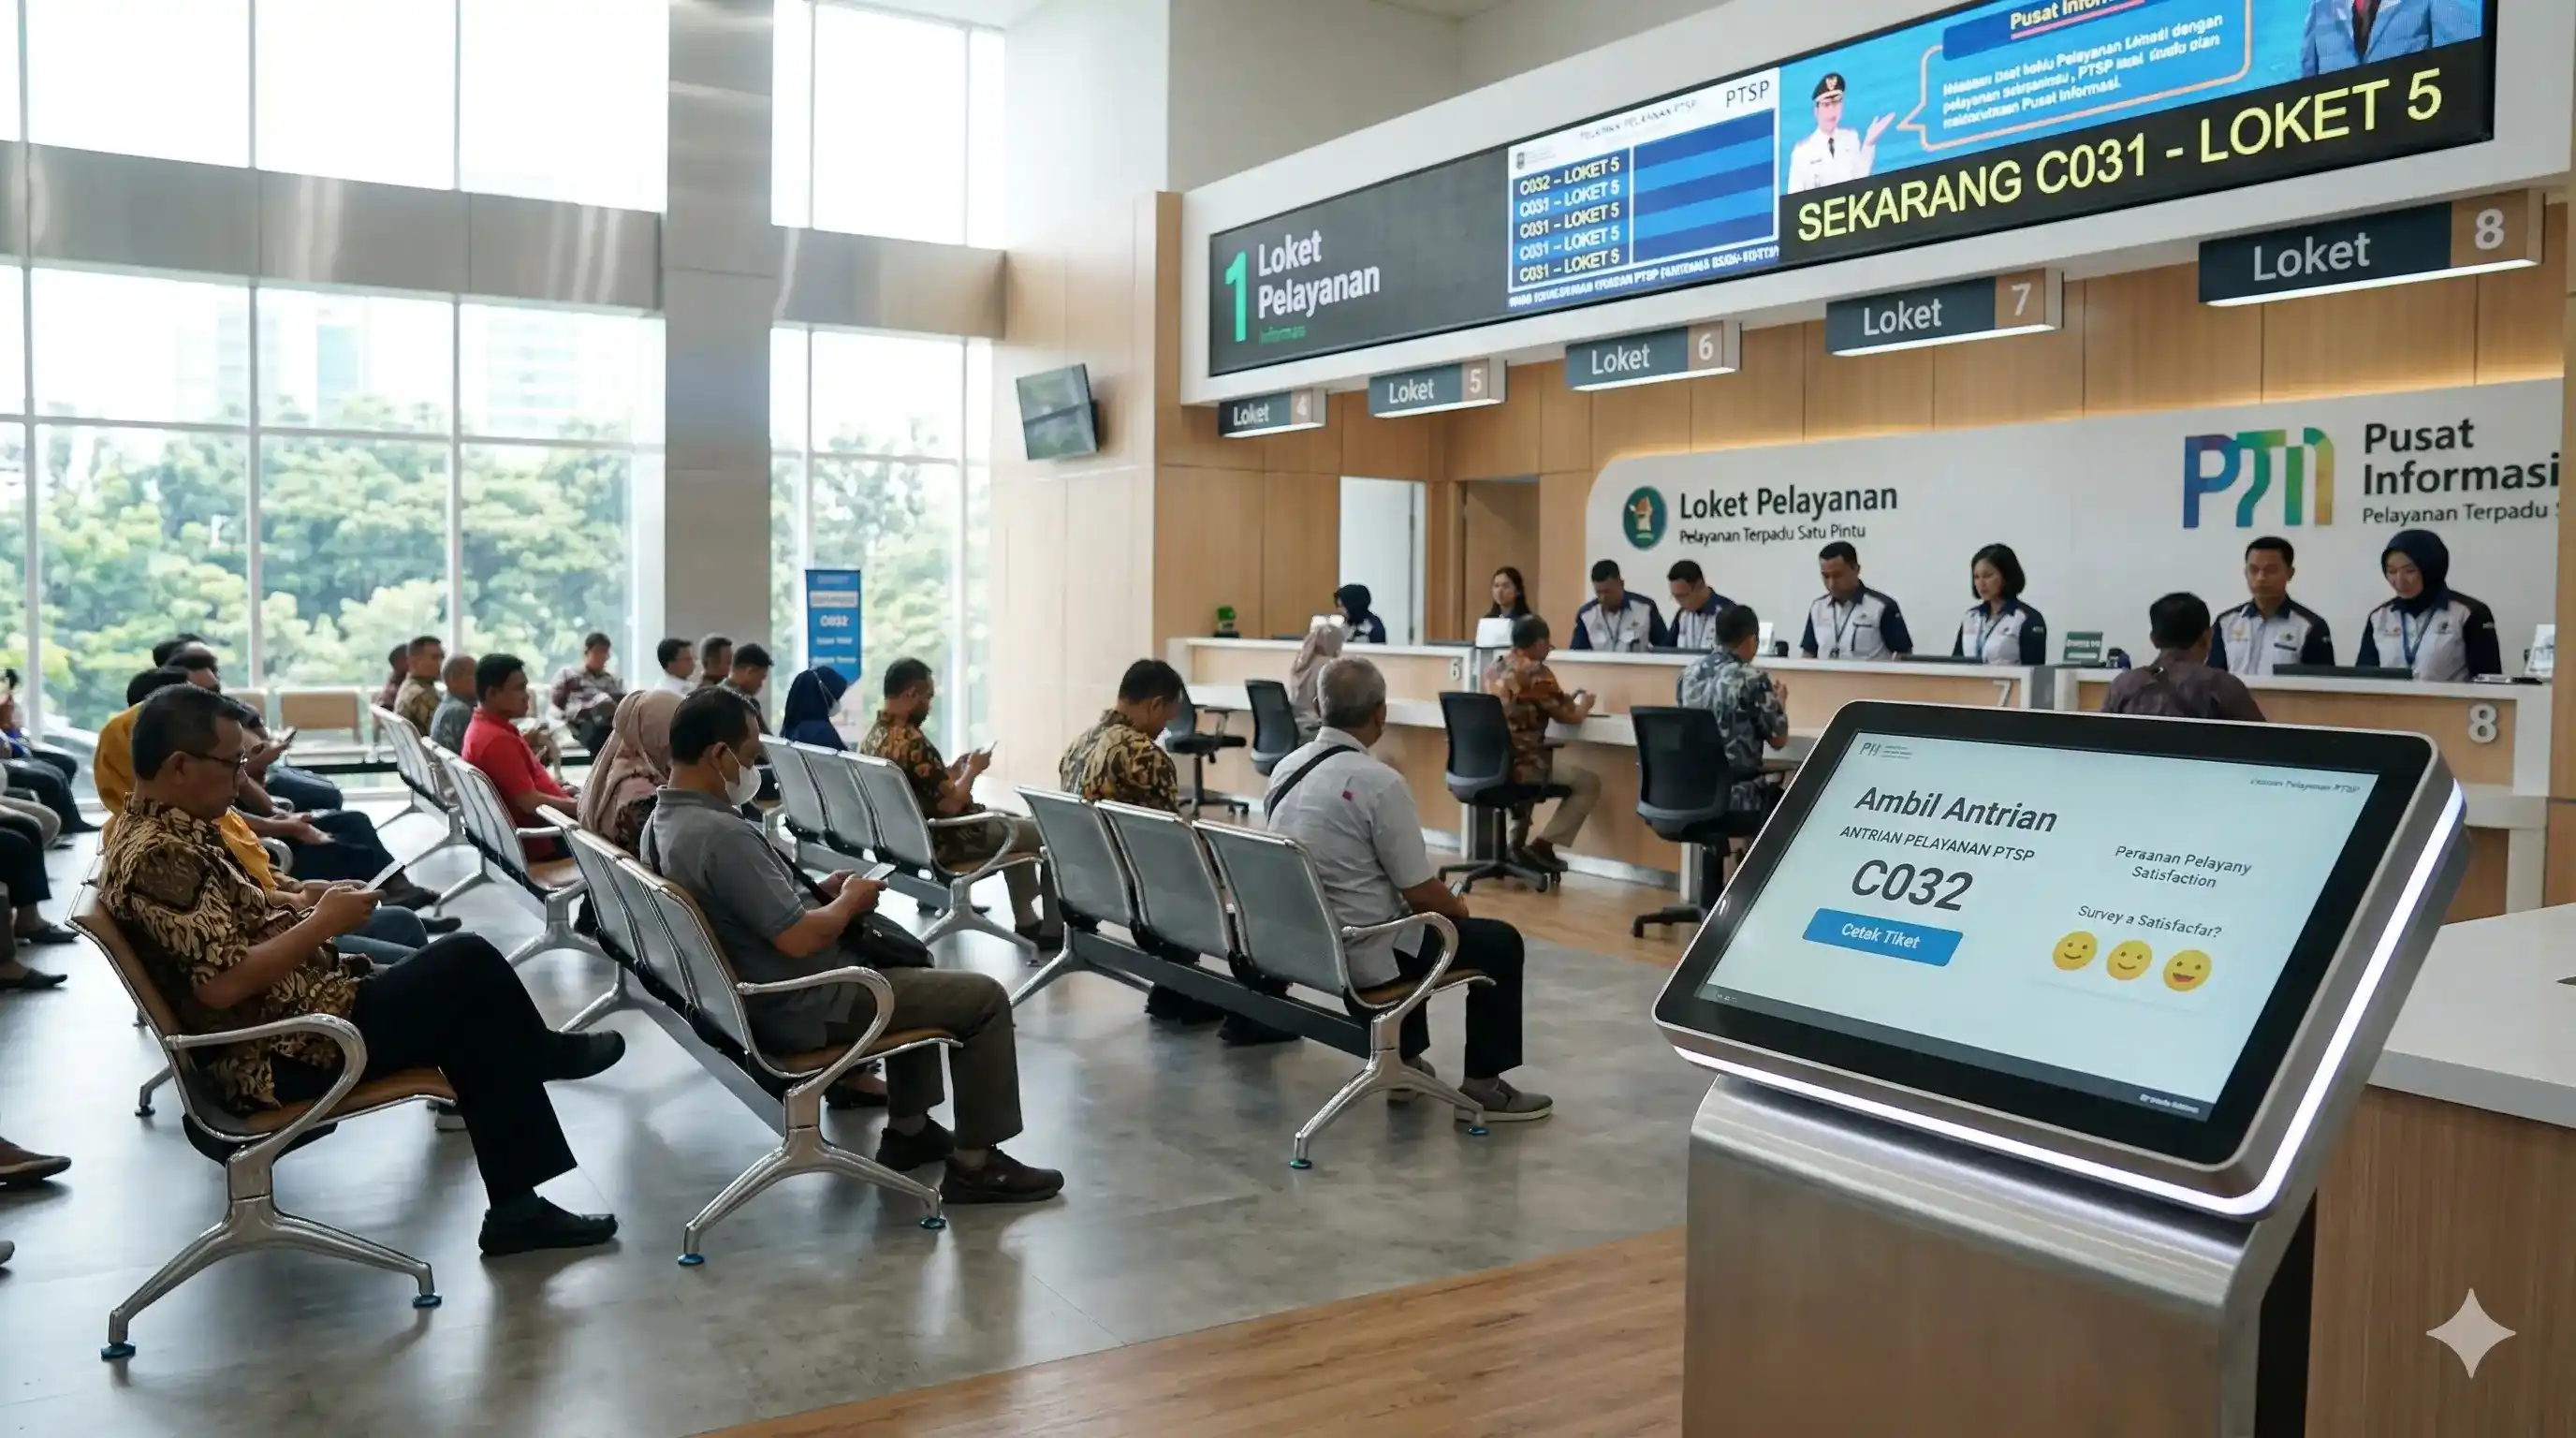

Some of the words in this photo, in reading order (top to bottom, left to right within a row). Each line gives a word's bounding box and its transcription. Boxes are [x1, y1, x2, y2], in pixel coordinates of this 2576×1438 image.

[2011, 3, 2058, 29] Pusat
[2078, 59, 2114, 80] PTSP
[1726, 80, 1769, 108] PTSP
[1797, 160, 2022, 242] SEKARANG
[2036, 132, 2144, 194] C031
[2165, 147, 2184, 158] -
[2200, 79, 2390, 163] LOKET
[2408, 67, 2442, 121] 5
[1564, 159, 1608, 184] LOKET
[1564, 182, 1608, 206] LOKET
[1564, 205, 1608, 228] LOKET
[1258, 229, 1322, 276] Loket
[1564, 227, 1608, 251] LOKET
[2254, 231, 2371, 282] Loket
[2475, 208, 2504, 250] 8
[1564, 250, 1608, 273] LOKET
[1225, 251, 1247, 342] 1
[1258, 266, 1380, 319] Pelayanan
[1863, 298, 1942, 337] Loket
[2011, 283, 2032, 316] 7
[1591, 343, 1650, 374] Loket
[1698, 334, 1713, 360] 6
[1388, 382, 1434, 404] Loket
[1470, 370, 1482, 393] 5
[1234, 404, 1269, 426] Loket
[2364, 418, 2474, 455] Pusat
[2364, 452, 2559, 496] Informasi
[1680, 489, 1749, 520] Loket
[1757, 485, 1897, 521] Pelayanan
[2363, 507, 2457, 527] Pelayanan
[2463, 500, 2548, 524] Terpadu
[1680, 530, 1740, 547] Pelayanan
[1745, 527, 1793, 545] Terpadu
[1797, 525, 1826, 540] Satu
[1831, 524, 1866, 538] Pintu
[1993, 680, 2012, 707] 7
[2468, 703, 2497, 744] 8
[1853, 786, 1942, 817] Ambil
[1941, 797, 2057, 832] Antrian
[1839, 826, 1903, 844] ANTRIAN
[1904, 833, 1992, 857] PELAYANAN
[1993, 845, 2035, 861] PTSP
[2131, 866, 2217, 888] Satisfaction
[2185, 854, 2252, 876] Pelayany
[1852, 859, 1973, 911] C032
[2078, 905, 2124, 925] Survey
[2126, 916, 2135, 925] a
[1883, 930, 1921, 949] Tiket
